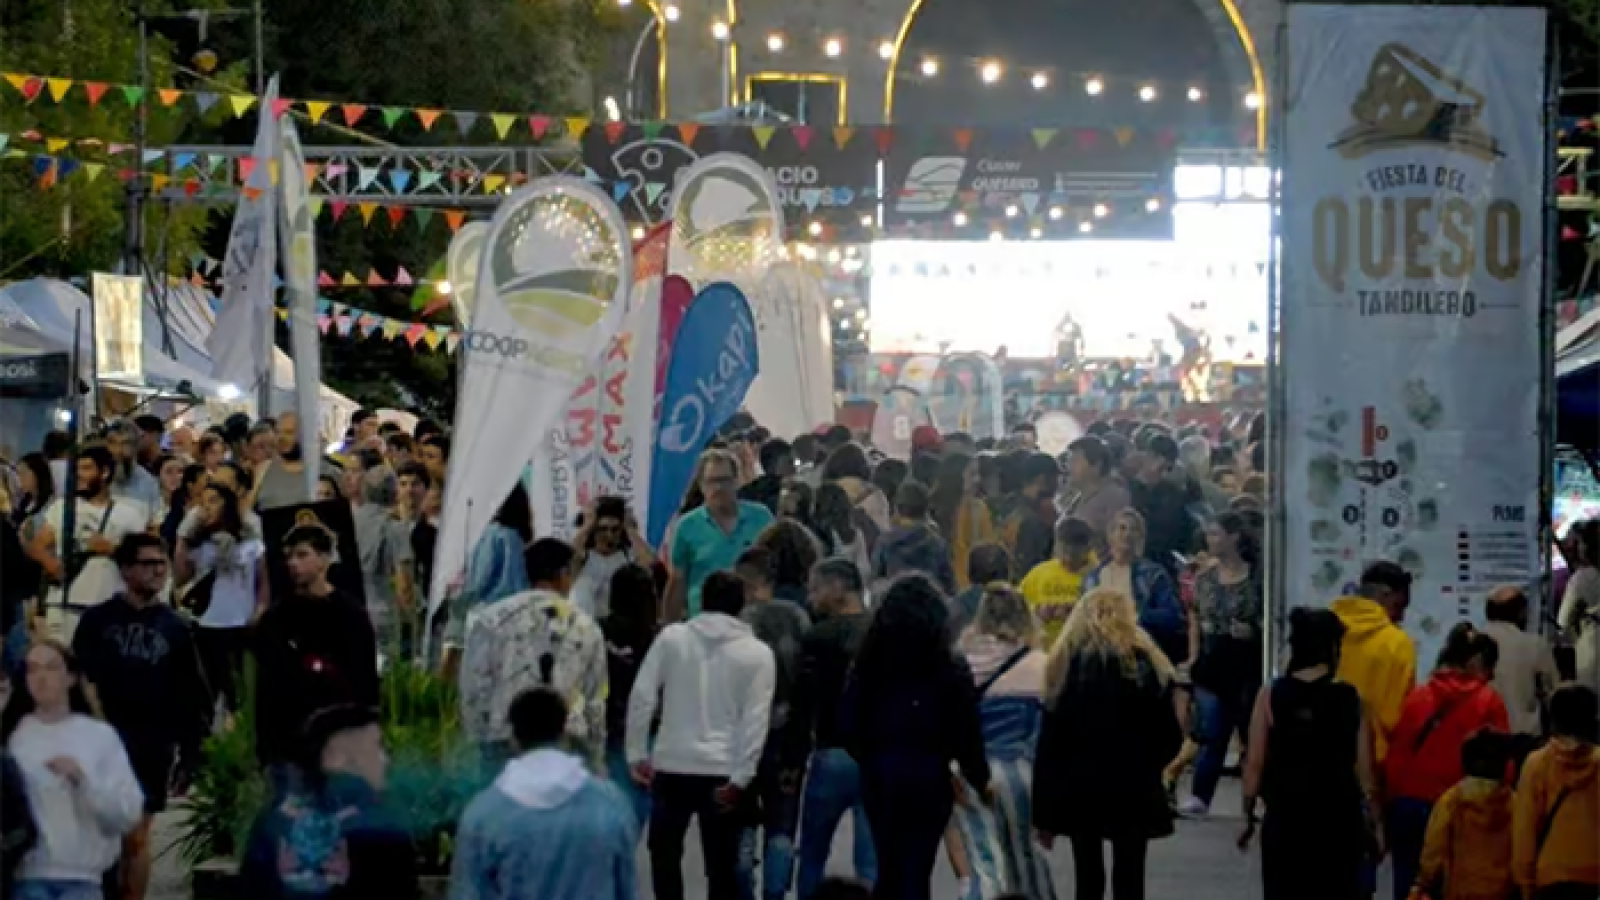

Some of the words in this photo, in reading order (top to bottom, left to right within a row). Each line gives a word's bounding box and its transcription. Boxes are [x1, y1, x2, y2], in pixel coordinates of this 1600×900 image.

[1367, 164, 1427, 192] FIESTA
[1435, 165, 1467, 193] DEL
[1312, 195, 1521, 293] QUESO
[1357, 290, 1476, 317] TANDILERO
